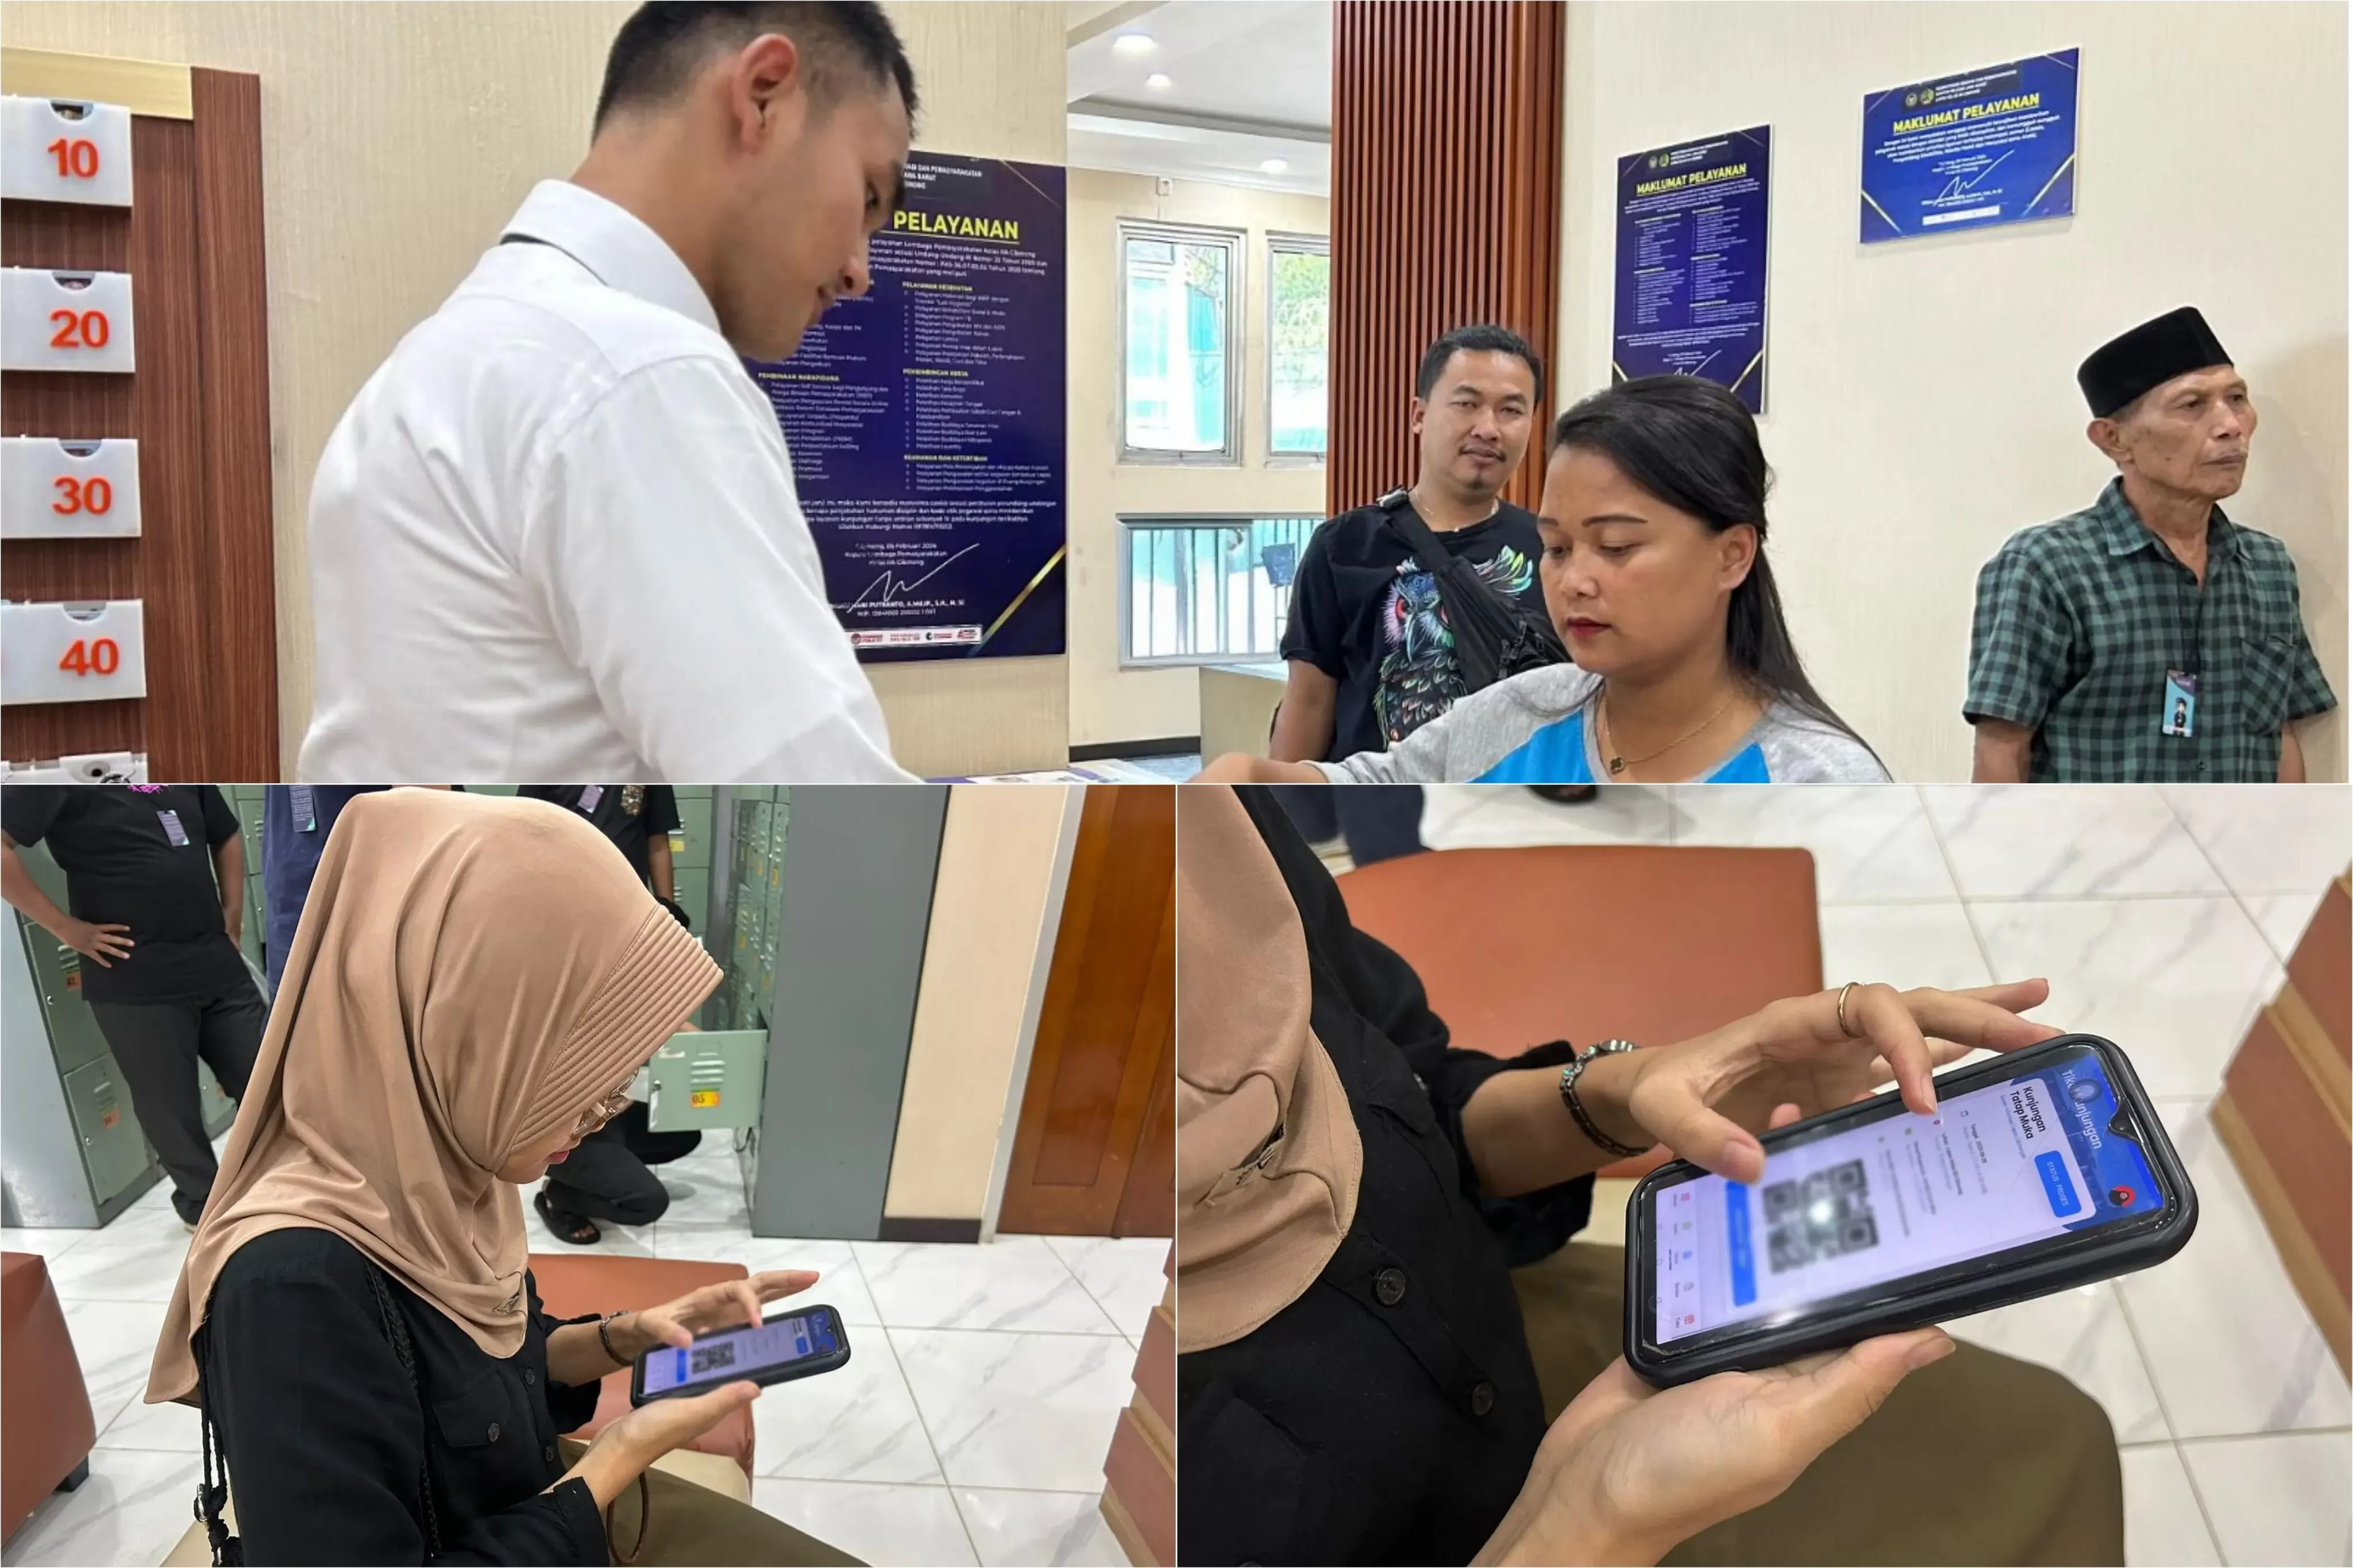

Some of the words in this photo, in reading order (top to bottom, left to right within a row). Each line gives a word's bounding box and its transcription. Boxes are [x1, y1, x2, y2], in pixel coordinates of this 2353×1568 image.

[1893, 109, 1961, 133] MAKLUMAT
[1963, 92, 2039, 119] PELAYANAN
[48, 138, 99, 178] 10
[1637, 175, 1687, 194] MAKLUMAT
[1689, 163, 1746, 183] PELAYANAN
[893, 210, 1019, 239] PELAYANAN
[51, 309, 109, 349] 20
[52, 476, 112, 515] 30
[60, 637, 119, 676] 40
[2009, 1090, 2025, 1115] Tatap
[2019, 1114, 2034, 1140] Muka
[2023, 1086, 2046, 1132] Kunjungan
[2046, 1161, 2059, 1181] STATUS
